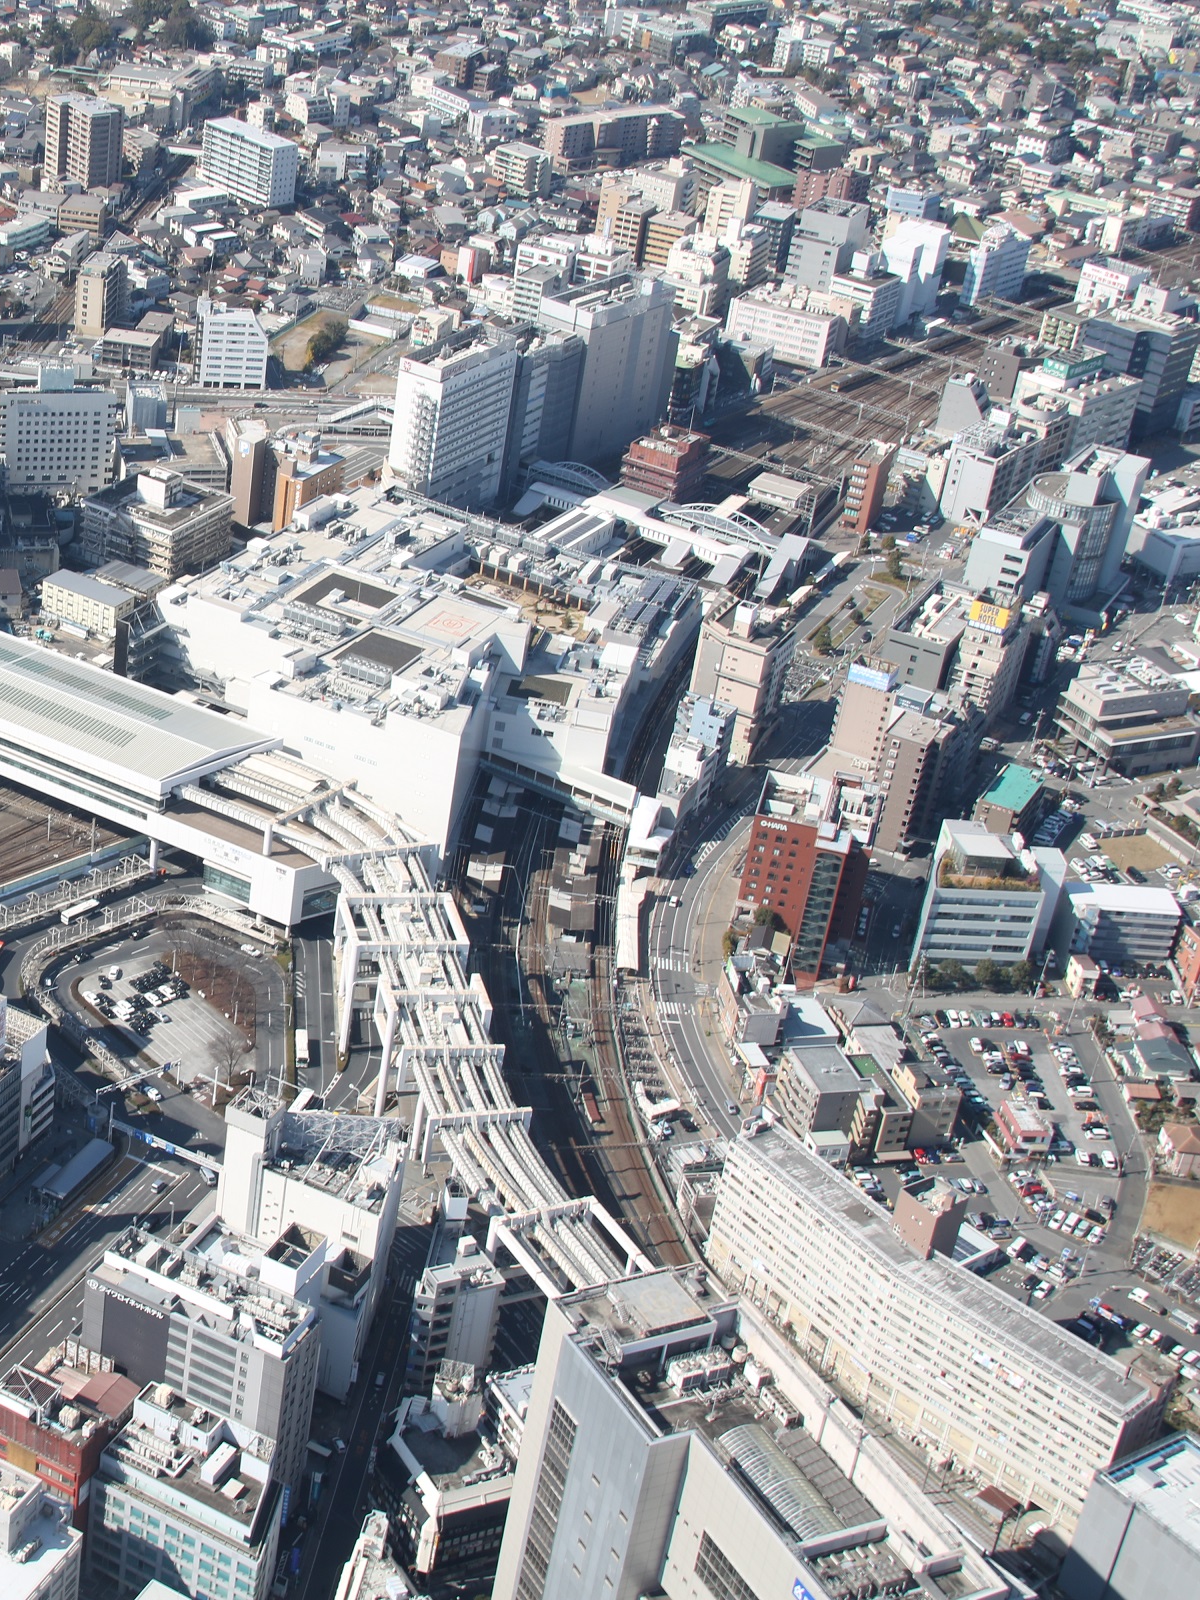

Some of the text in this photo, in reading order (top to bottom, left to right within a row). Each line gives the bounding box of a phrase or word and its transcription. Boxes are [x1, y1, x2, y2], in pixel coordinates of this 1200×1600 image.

[979, 603, 1000, 616] SUPER
[978, 613, 997, 626] HOTEL
[99, 1284, 165, 1320] ダイワロイネットホテル
